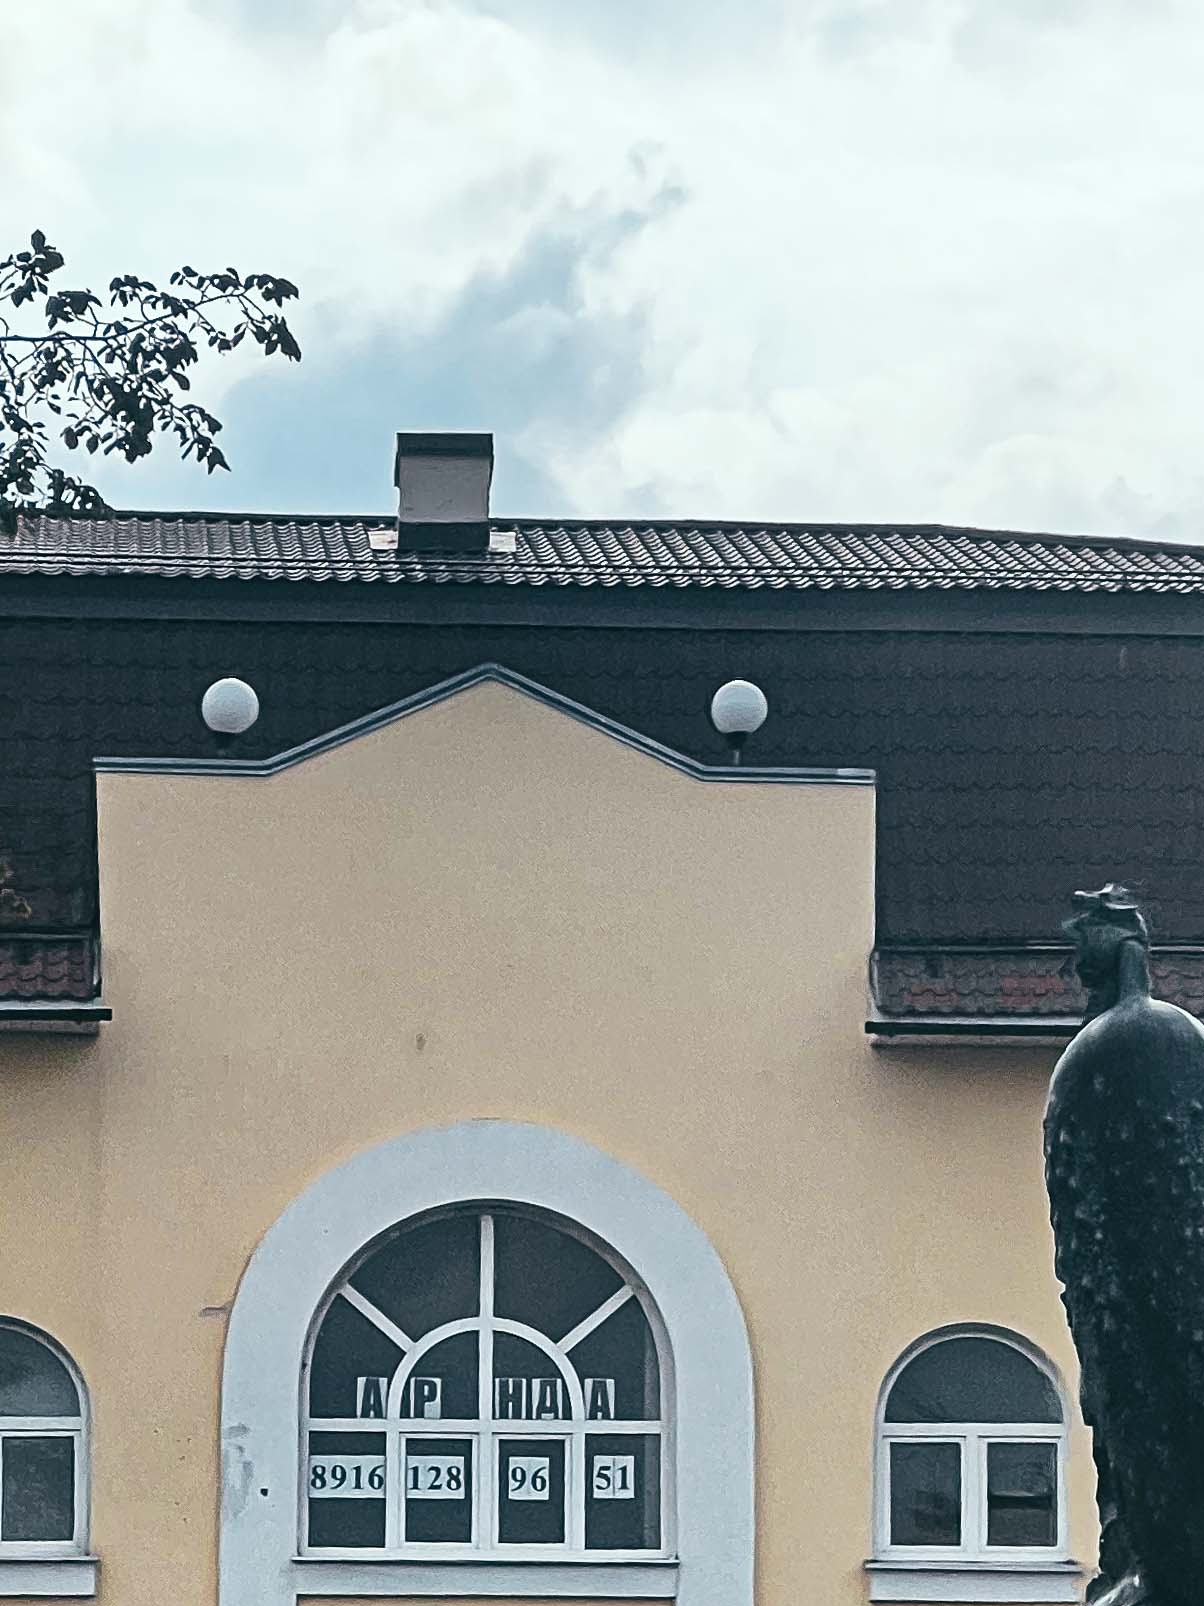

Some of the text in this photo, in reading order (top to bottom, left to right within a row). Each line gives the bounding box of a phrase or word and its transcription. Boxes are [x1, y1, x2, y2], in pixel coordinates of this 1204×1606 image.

[310, 1463, 630, 1492] 8916 128 96 51
